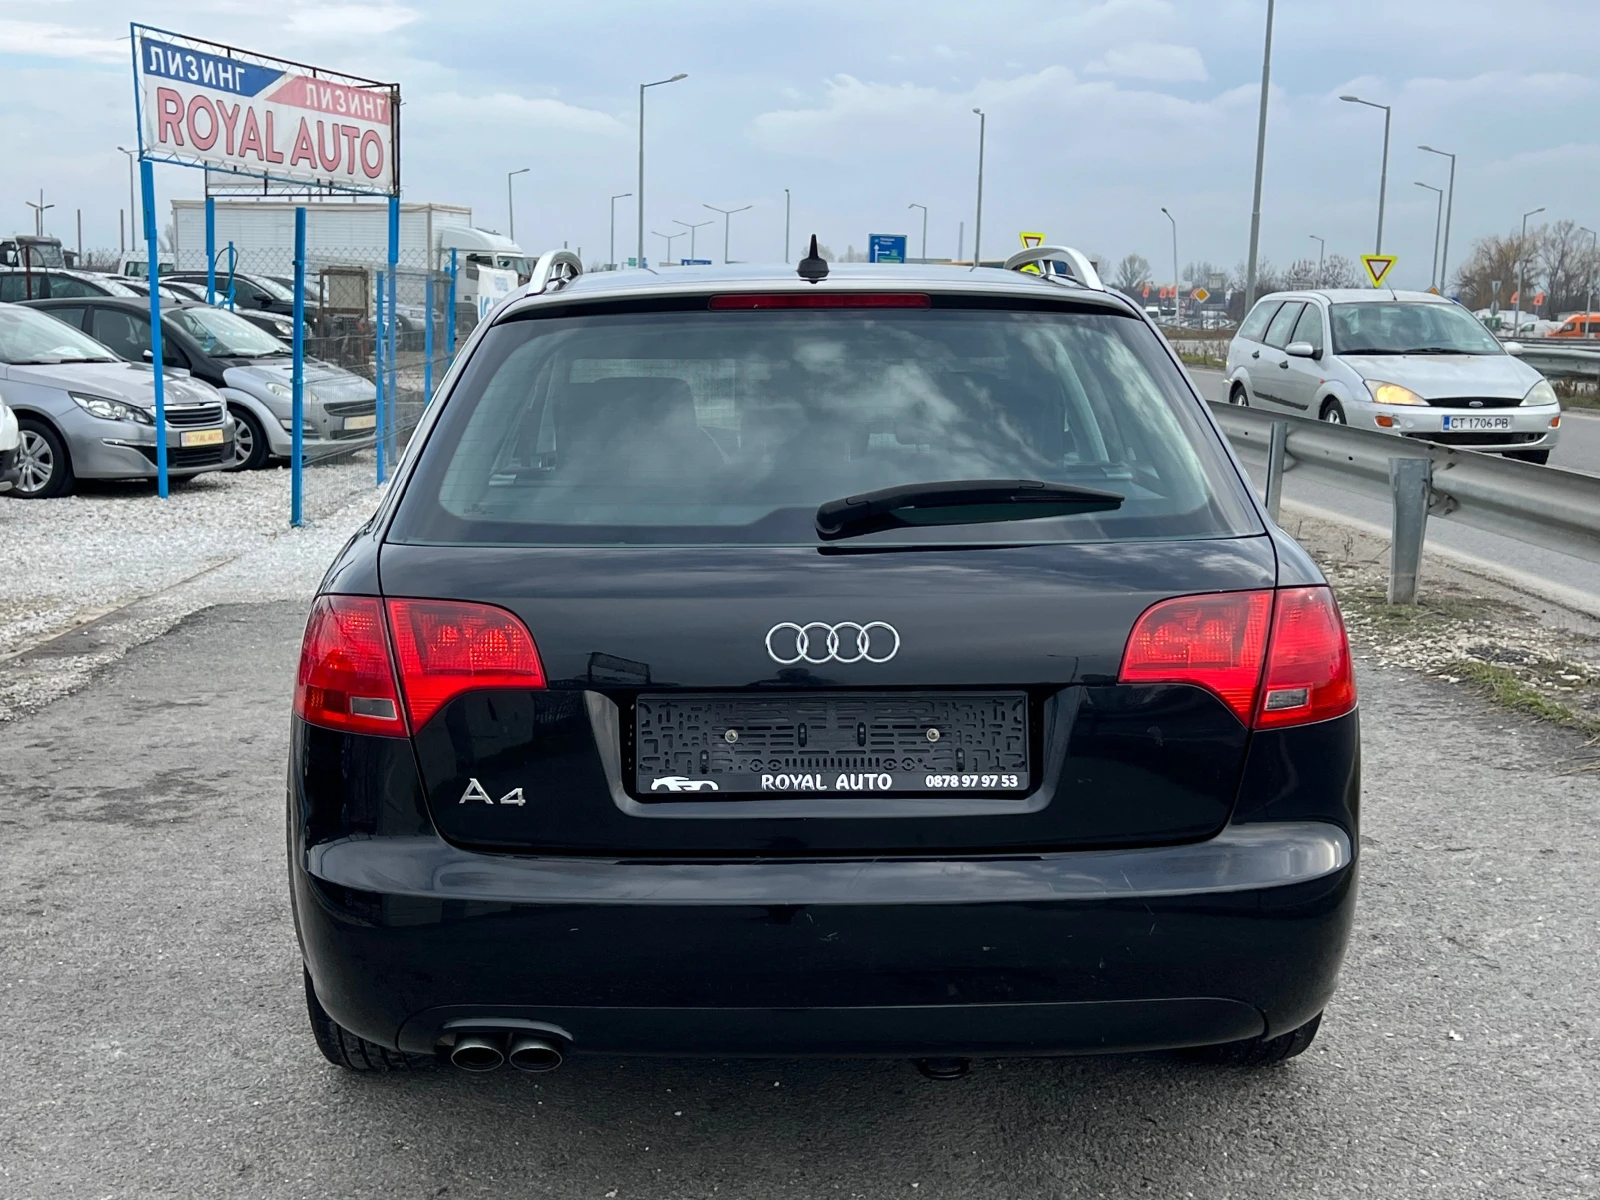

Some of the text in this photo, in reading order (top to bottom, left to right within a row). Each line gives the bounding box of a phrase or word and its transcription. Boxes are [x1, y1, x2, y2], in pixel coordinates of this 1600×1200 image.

[150, 46, 246, 91] ЛИЗИНГ
[306, 84, 385, 120] ЛИЗИНГ
[157, 87, 384, 179] ROYAL AUTO
[1451, 418, 1508, 429] CT 1706 PB
[761, 773, 1018, 790] ROYAL AUTO 0878 97 97 53
